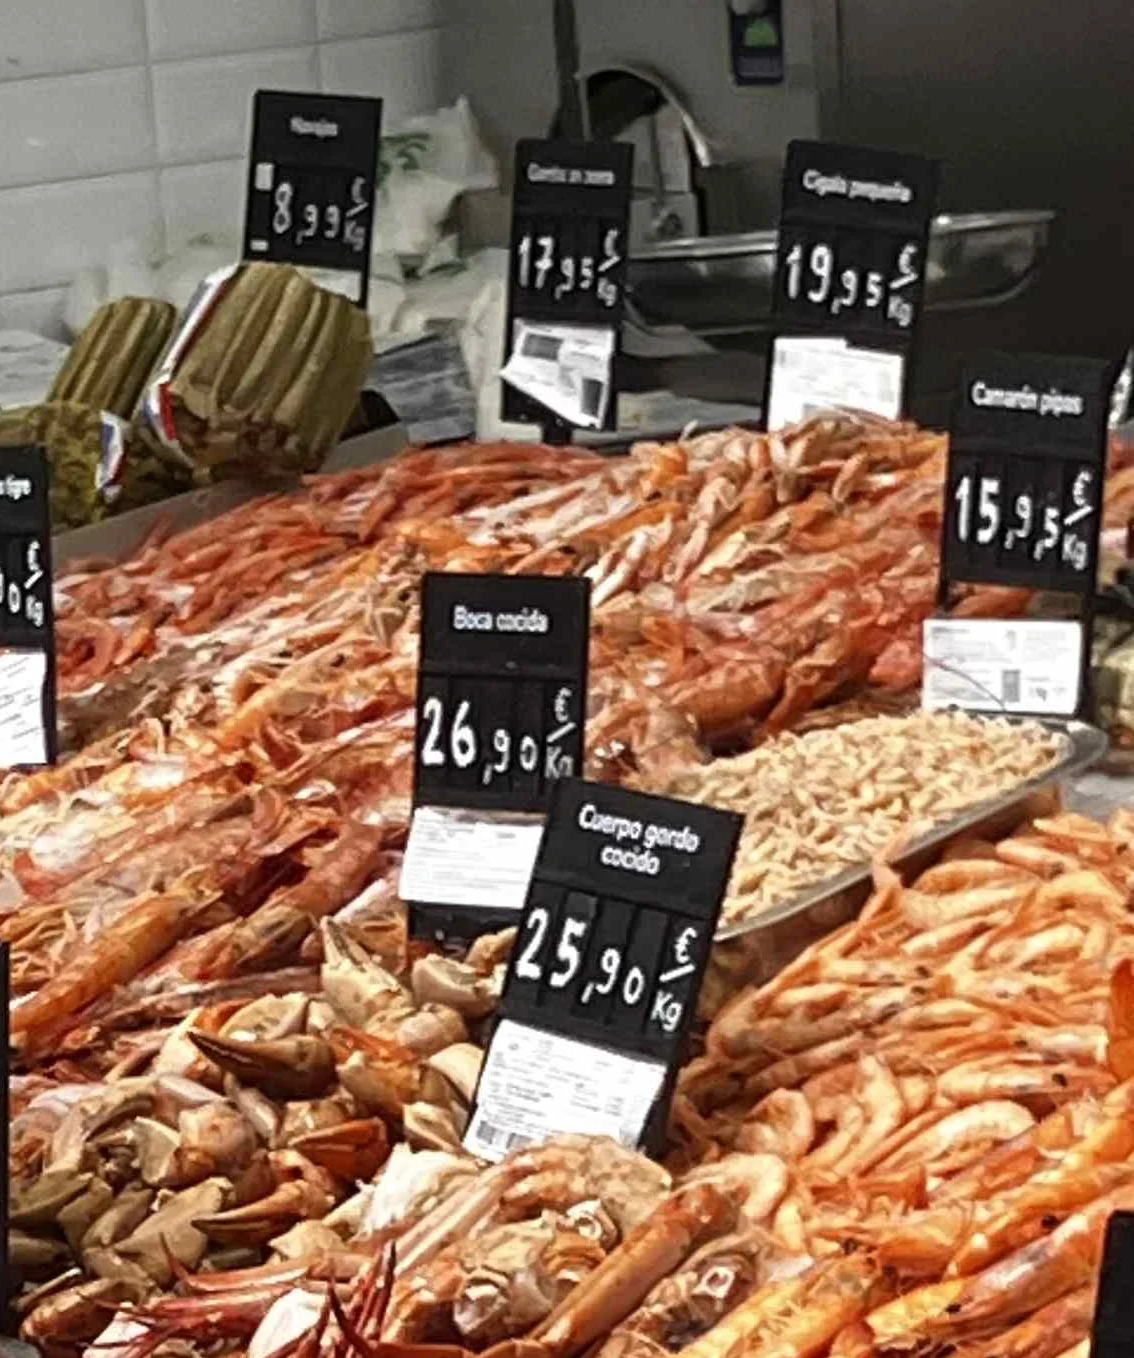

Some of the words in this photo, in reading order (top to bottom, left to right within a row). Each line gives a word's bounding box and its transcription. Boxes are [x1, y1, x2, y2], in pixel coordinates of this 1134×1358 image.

[518, 235, 595, 300] 17,95
[786, 243, 883, 315] 19,95
[452, 605, 493, 631] Boca
[422, 696, 539, 786] 26,90
[578, 803, 643, 842] Cuerpo
[516, 907, 645, 1005] 25,90
